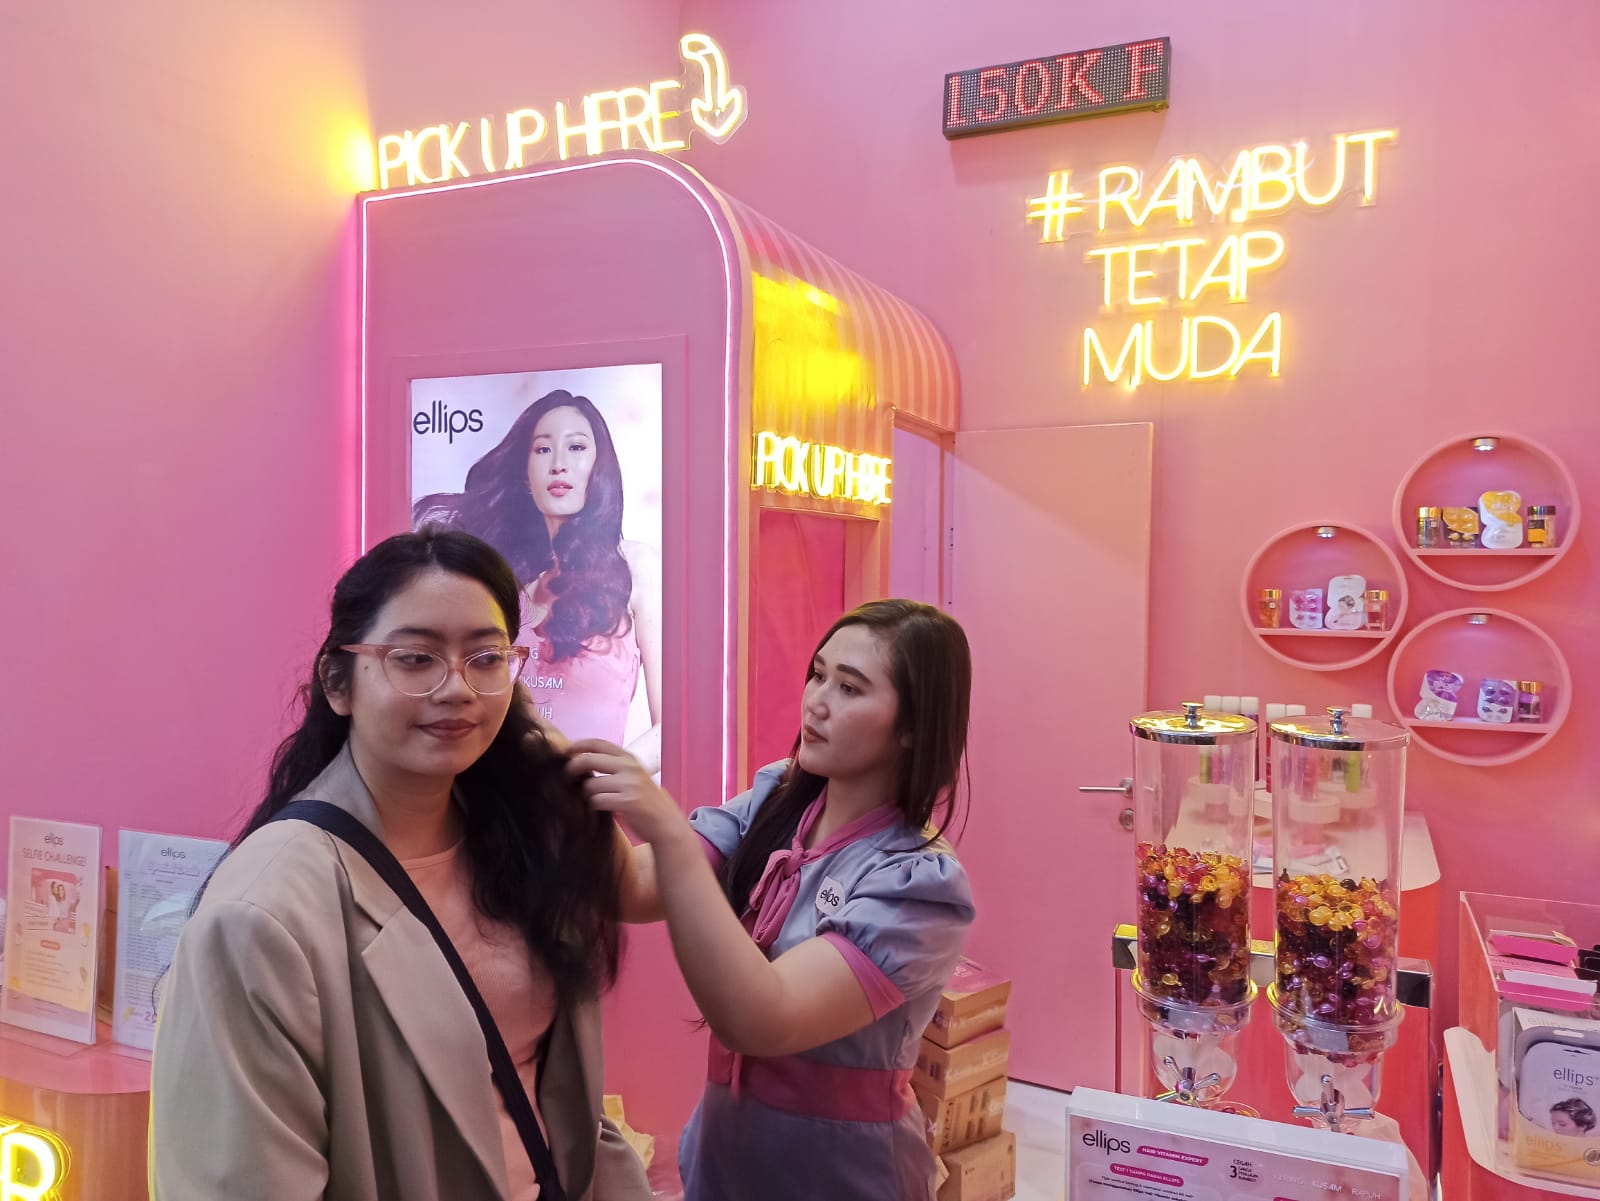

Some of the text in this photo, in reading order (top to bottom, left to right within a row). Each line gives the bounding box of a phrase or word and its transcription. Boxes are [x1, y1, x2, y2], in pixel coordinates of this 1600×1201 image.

[377, 80, 686, 190] PICK UP HERE
[1087, 230, 1285, 307] TETAP
[1082, 312, 1282, 389] MUDA
[412, 400, 484, 444] ellips
[523, 676, 564, 690] KUSAM
[160, 847, 186, 860] ellips
[1553, 1067, 1594, 1086] ellips
[1082, 1129, 1131, 1156] ellips
[1229, 1165, 1238, 1178] 3
[1311, 1180, 1343, 1193] KUSAM
